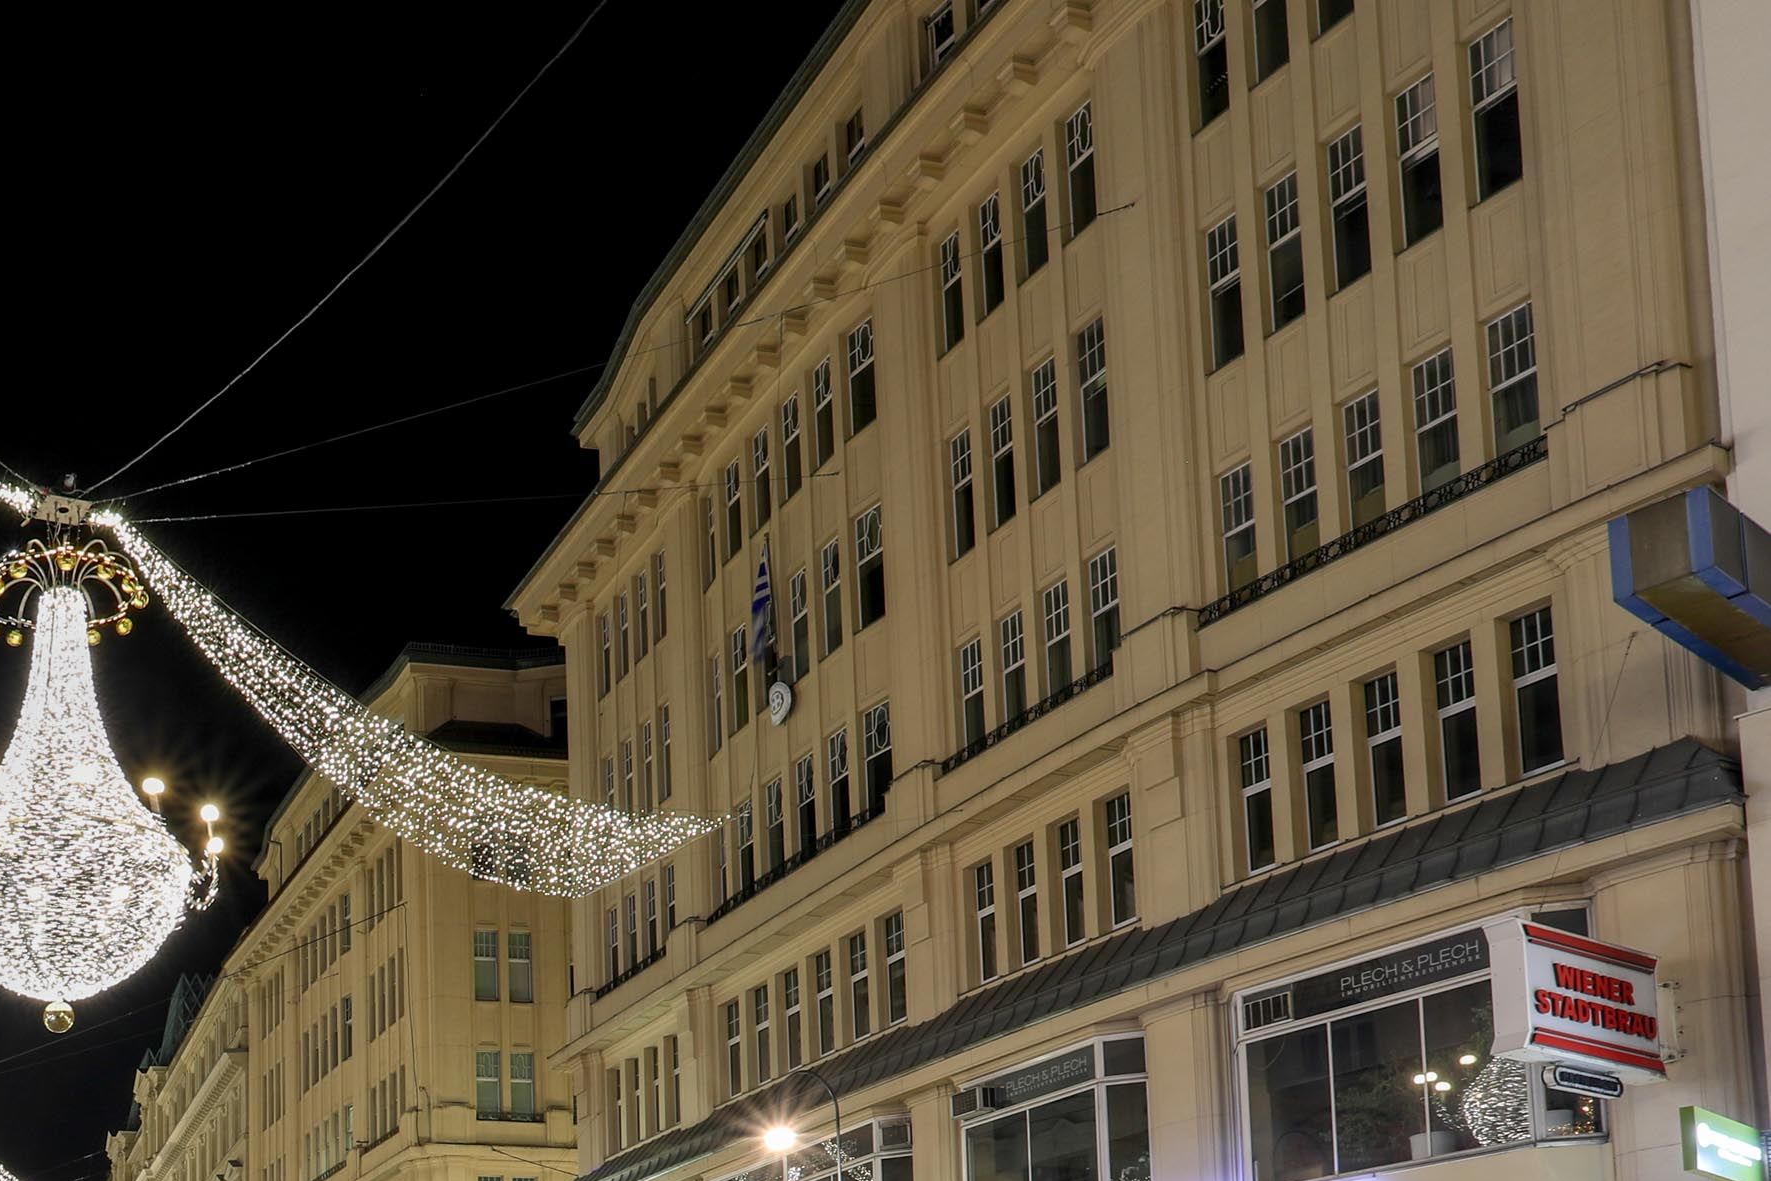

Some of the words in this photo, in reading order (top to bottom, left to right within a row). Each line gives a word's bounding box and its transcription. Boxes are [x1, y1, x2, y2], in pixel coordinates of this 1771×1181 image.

[1340, 963, 1398, 991] PLECH
[1402, 960, 1414, 973] &
[1417, 940, 1479, 969] PLECH
[1553, 963, 1635, 1005] WIENER
[1006, 1073, 1040, 1093] PLECH
[1042, 1070, 1049, 1080] &
[1051, 1056, 1087, 1079] PLECH
